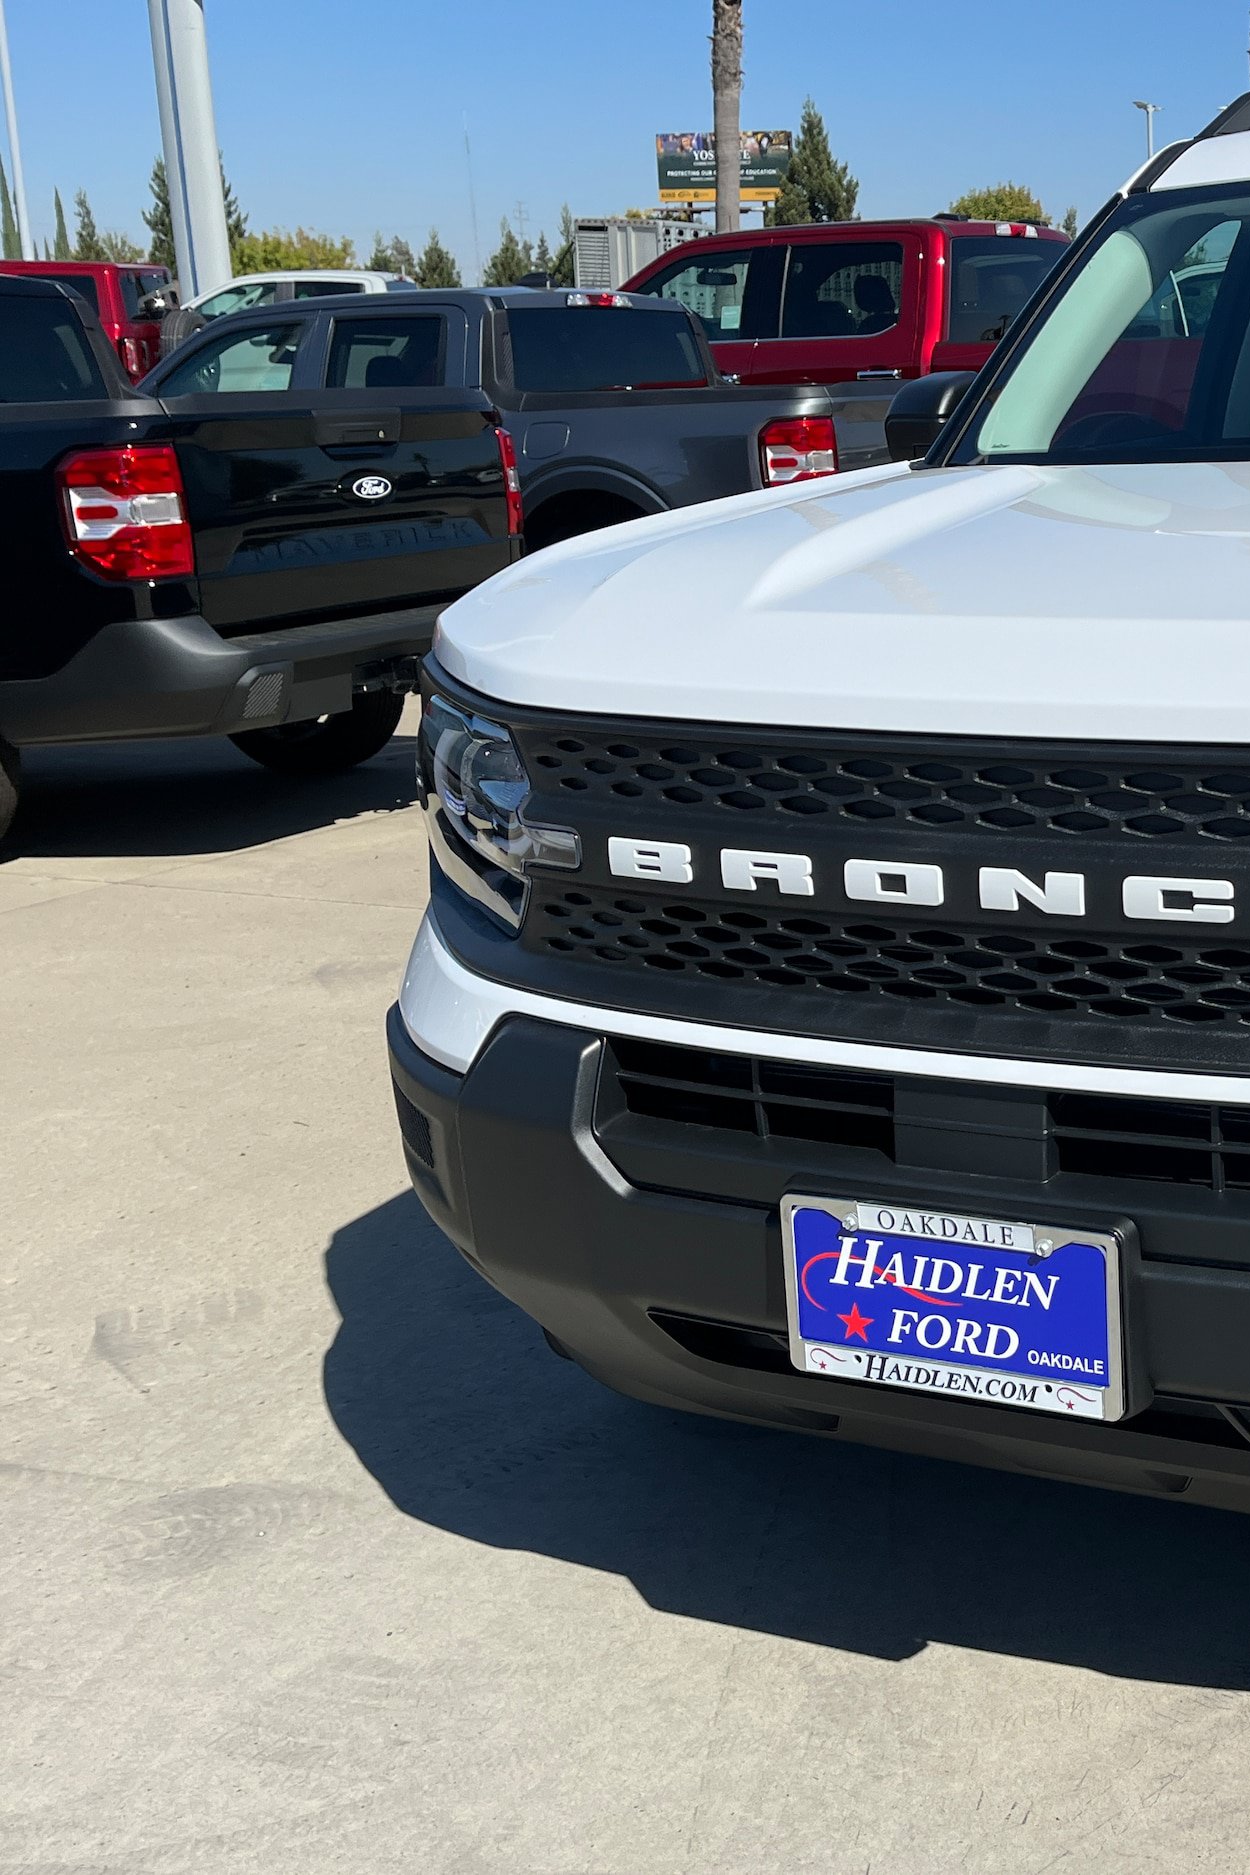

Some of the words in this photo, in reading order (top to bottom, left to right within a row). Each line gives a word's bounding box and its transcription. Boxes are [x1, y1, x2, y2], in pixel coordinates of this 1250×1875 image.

[693, 149, 751, 160] YOSE
[359, 478, 387, 495] Ford
[252, 521, 472, 562] MAVERICK
[877, 1209, 1015, 1247] OAKDALE
[829, 1235, 1060, 1311] HAIDLEN
[887, 1308, 1020, 1359] FORD
[863, 1353, 1040, 1403] HAIDLEN.COM
[1027, 1349, 1104, 1375] OAKDALE
